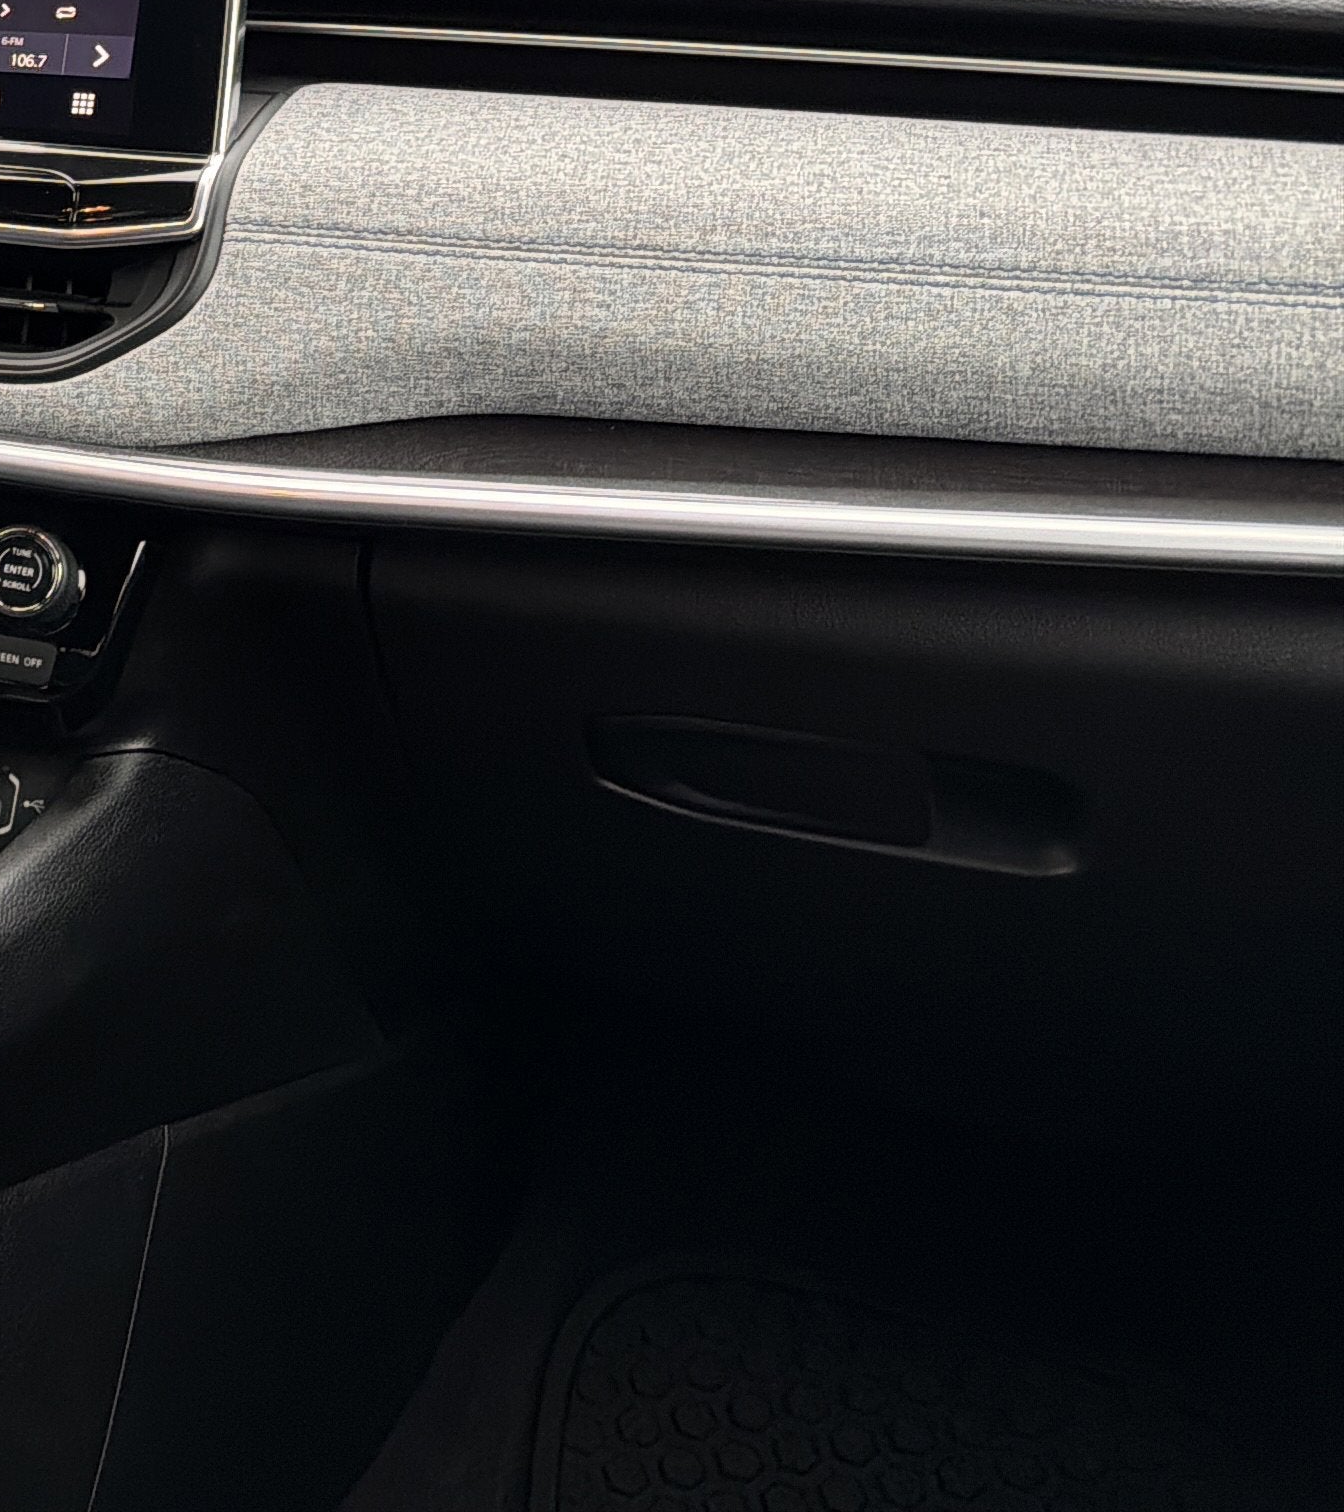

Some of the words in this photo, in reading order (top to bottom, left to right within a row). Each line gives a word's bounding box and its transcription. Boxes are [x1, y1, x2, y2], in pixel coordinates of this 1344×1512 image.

[1, 36, 25, 47] 6-FM
[11, 52, 48, 68] 106.7
[12, 546, 33, 559] TUNE
[3, 563, 35, 578] ENTER
[2, 578, 32, 593] SCROLL
[23, 656, 43, 669] OFF
